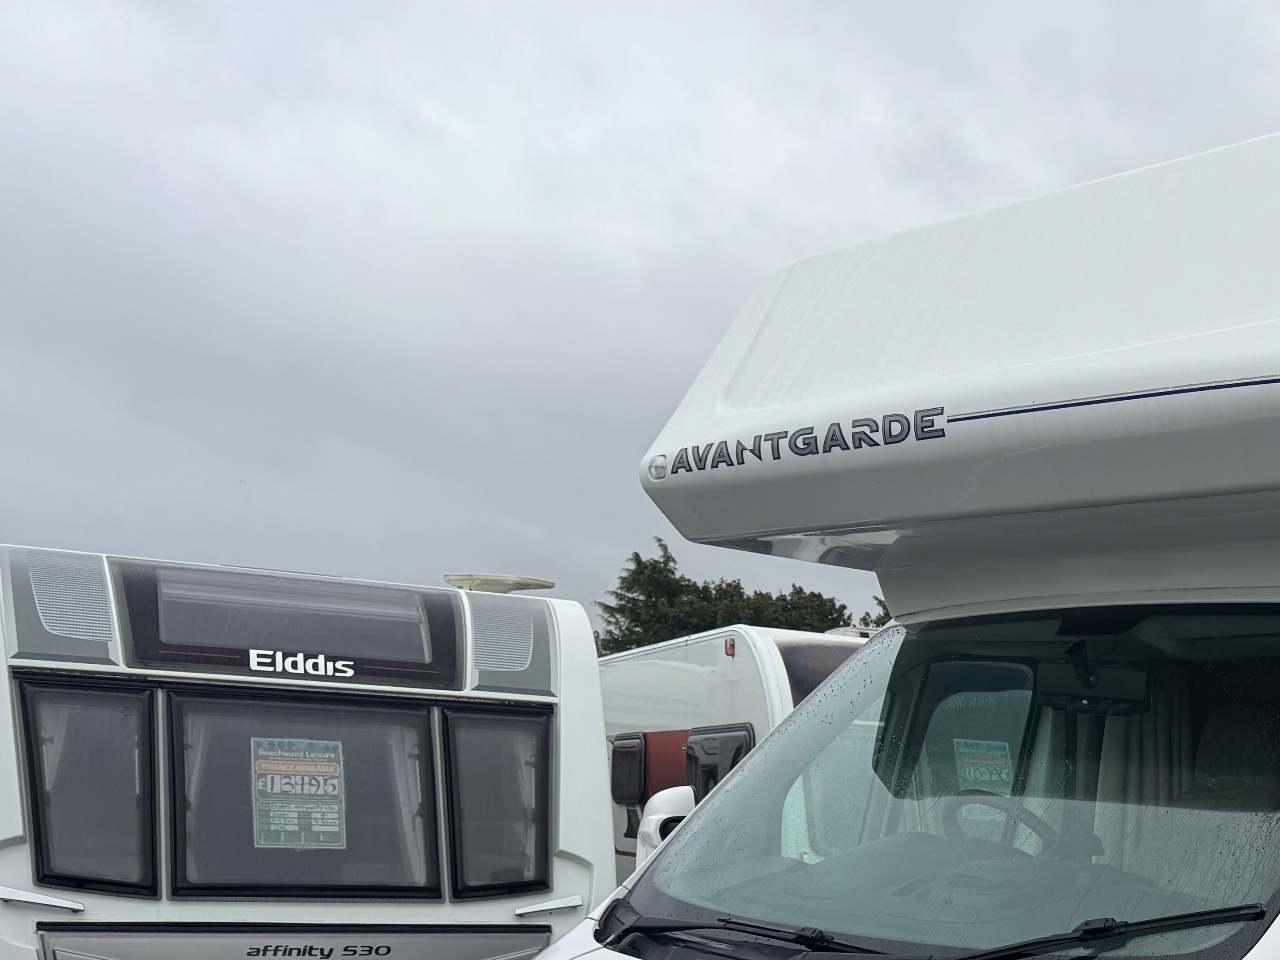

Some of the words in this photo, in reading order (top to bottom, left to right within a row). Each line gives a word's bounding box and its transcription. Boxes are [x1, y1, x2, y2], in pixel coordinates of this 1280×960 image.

[670, 406, 946, 475] AVANTGARDE
[249, 649, 355, 678] Elddis
[258, 748, 304, 757] Beechwood
[305, 750, 336, 759] Leisure
[261, 763, 294, 771] FINANCE
[295, 765, 336, 773] AVAILABLE
[246, 945, 335, 959] affinity
[341, 945, 392, 957] 530
